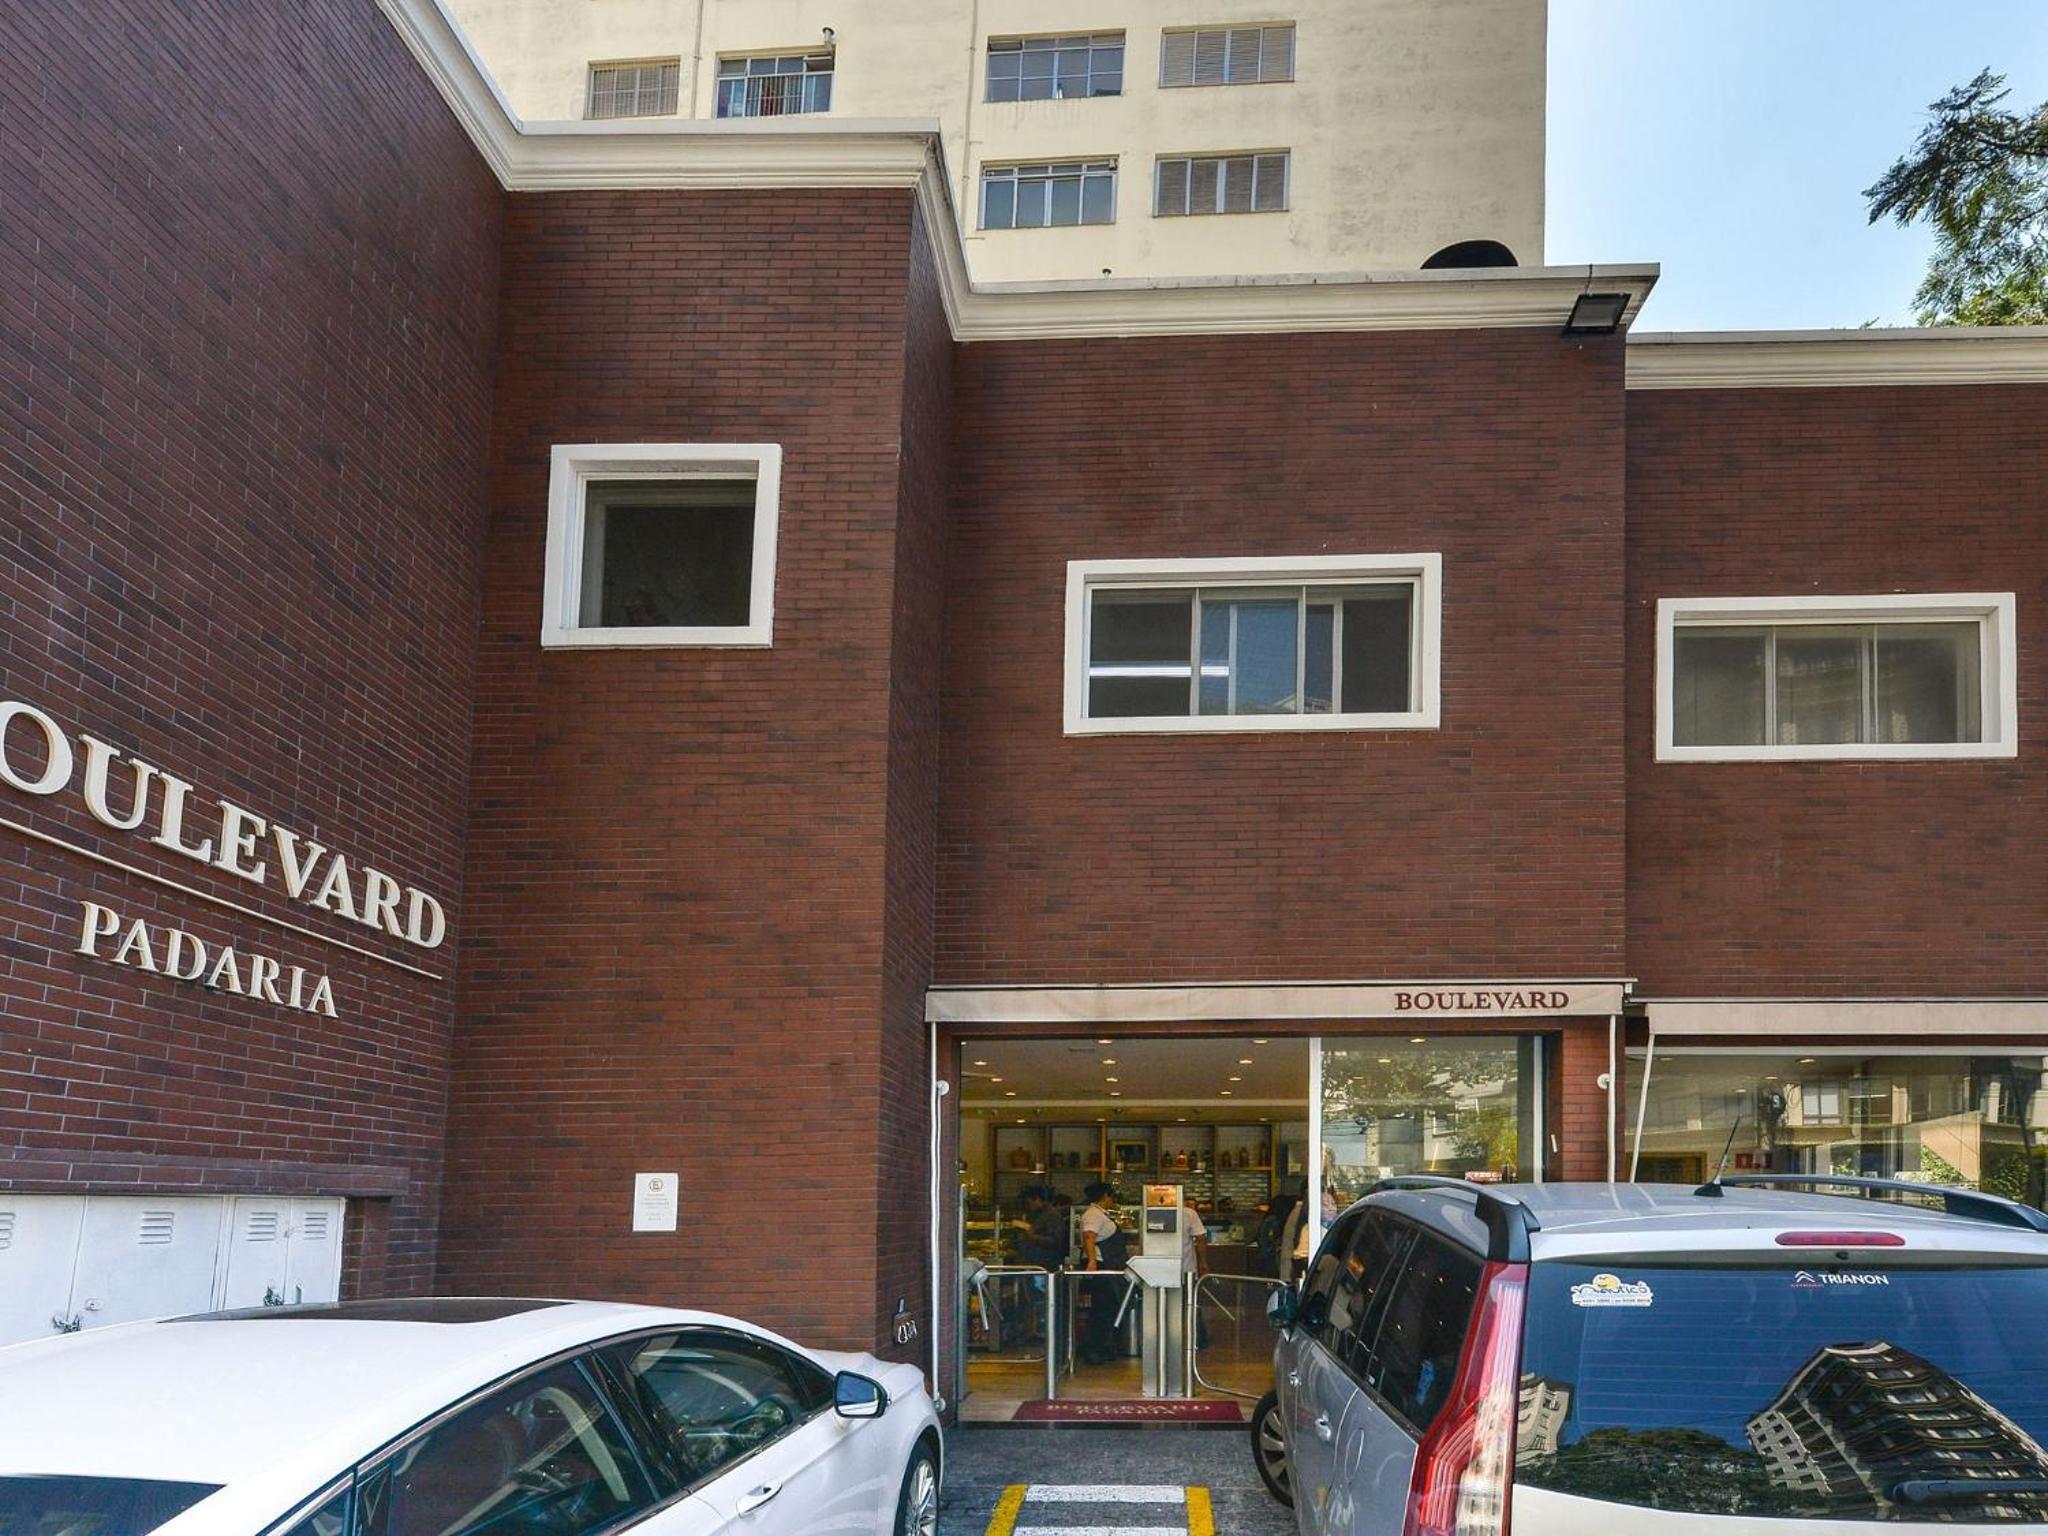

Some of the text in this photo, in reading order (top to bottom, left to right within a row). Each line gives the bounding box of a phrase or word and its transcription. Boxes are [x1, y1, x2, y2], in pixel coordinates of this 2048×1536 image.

[74, 900, 339, 1018] PADARIA
[1394, 991, 1570, 1011] BOULEVARD
[1818, 1273, 1890, 1285] TRIANON
